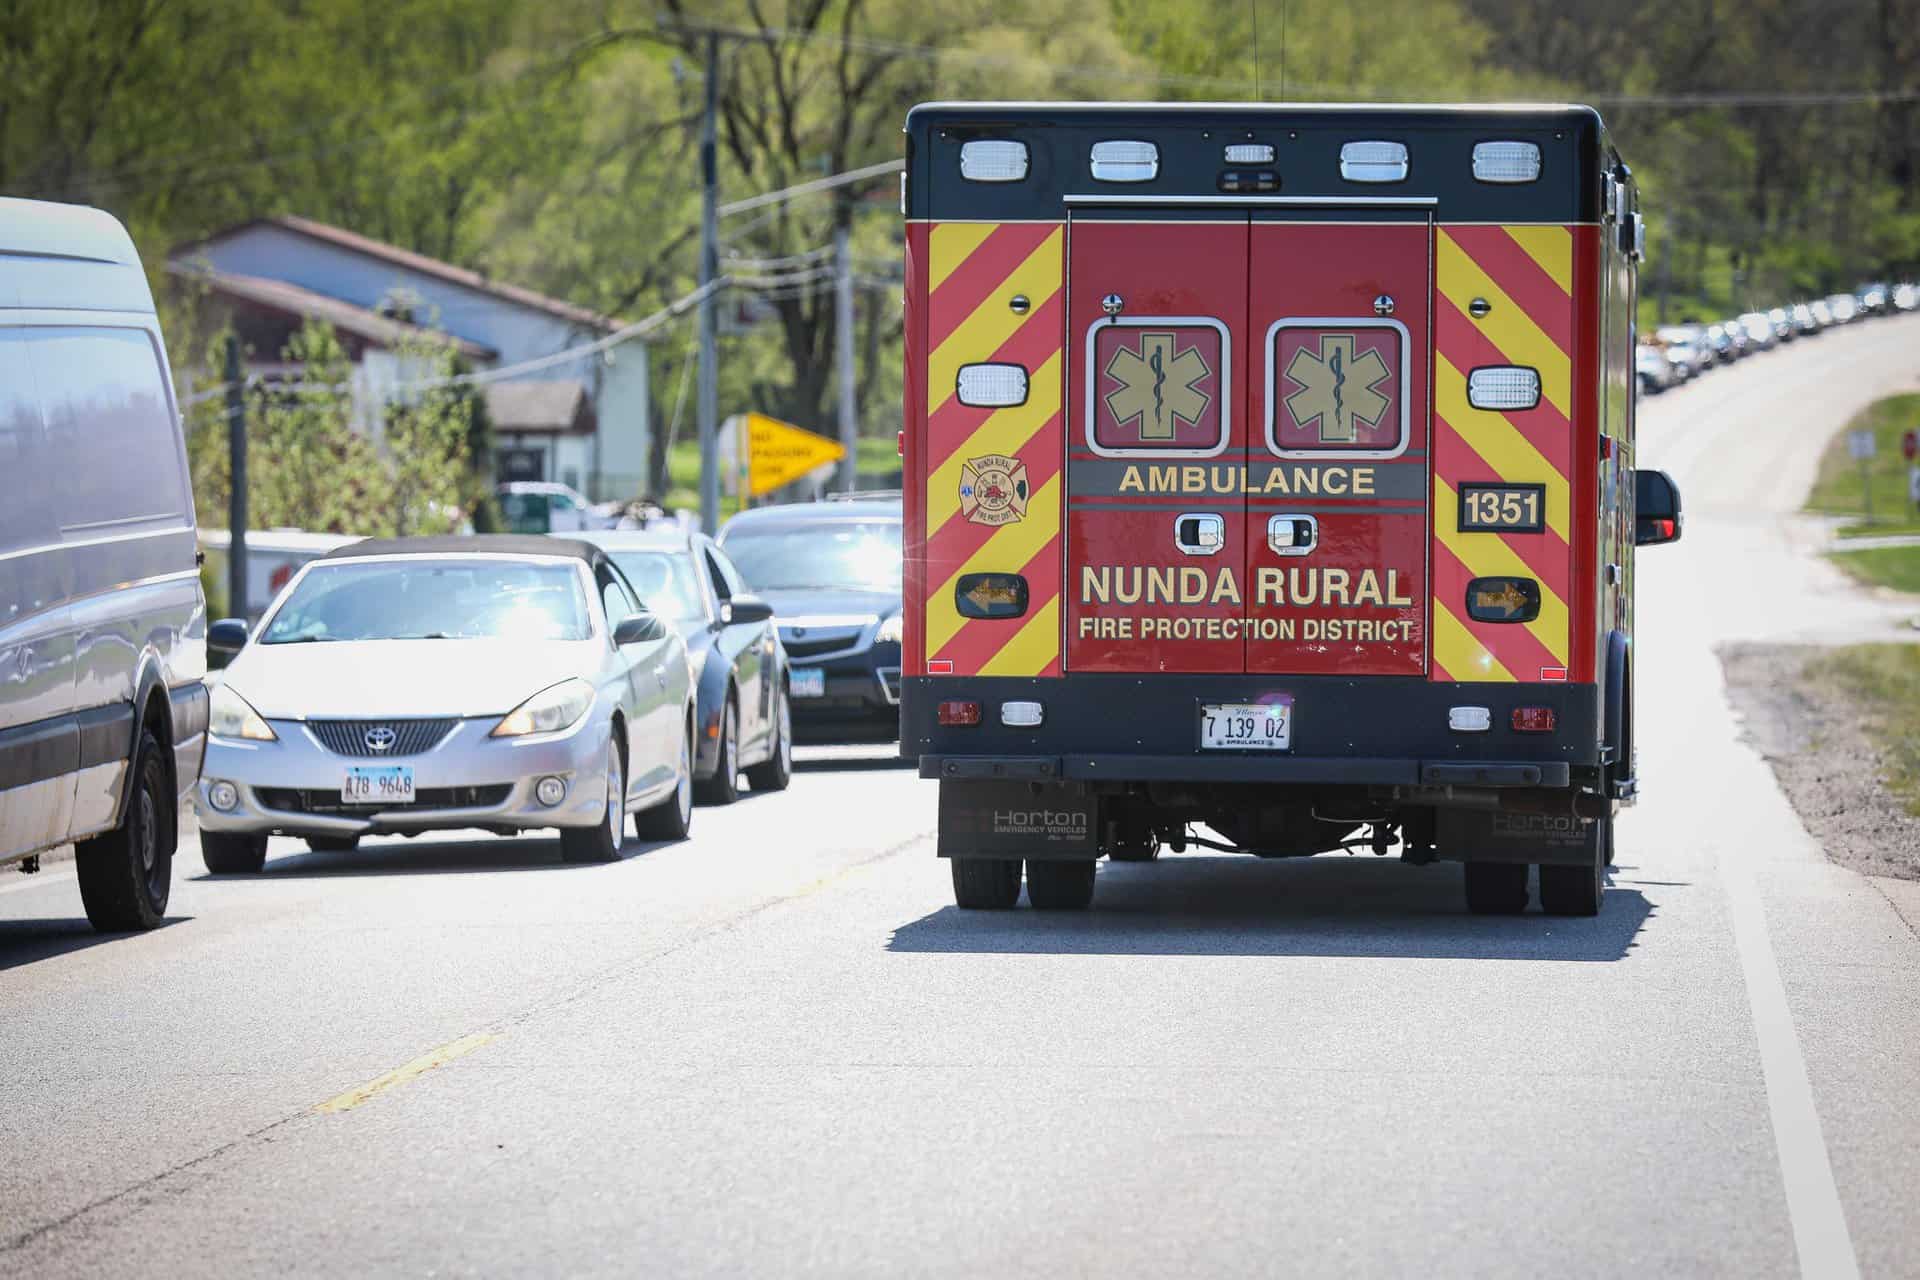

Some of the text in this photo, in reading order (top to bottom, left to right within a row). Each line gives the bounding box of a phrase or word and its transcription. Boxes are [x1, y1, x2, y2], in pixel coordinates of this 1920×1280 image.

[1118, 465, 1376, 494] AMBULANCE
[1465, 492, 1537, 524] 1351
[1081, 566, 1412, 606] NUNDA RURAL
[1079, 617, 1414, 642] FIRE PROTECTION DISTRICT
[1206, 716, 1216, 738] 7
[1225, 716, 1255, 738] 139
[379, 775, 412, 794] 9648
[994, 809, 1087, 826] Horton
